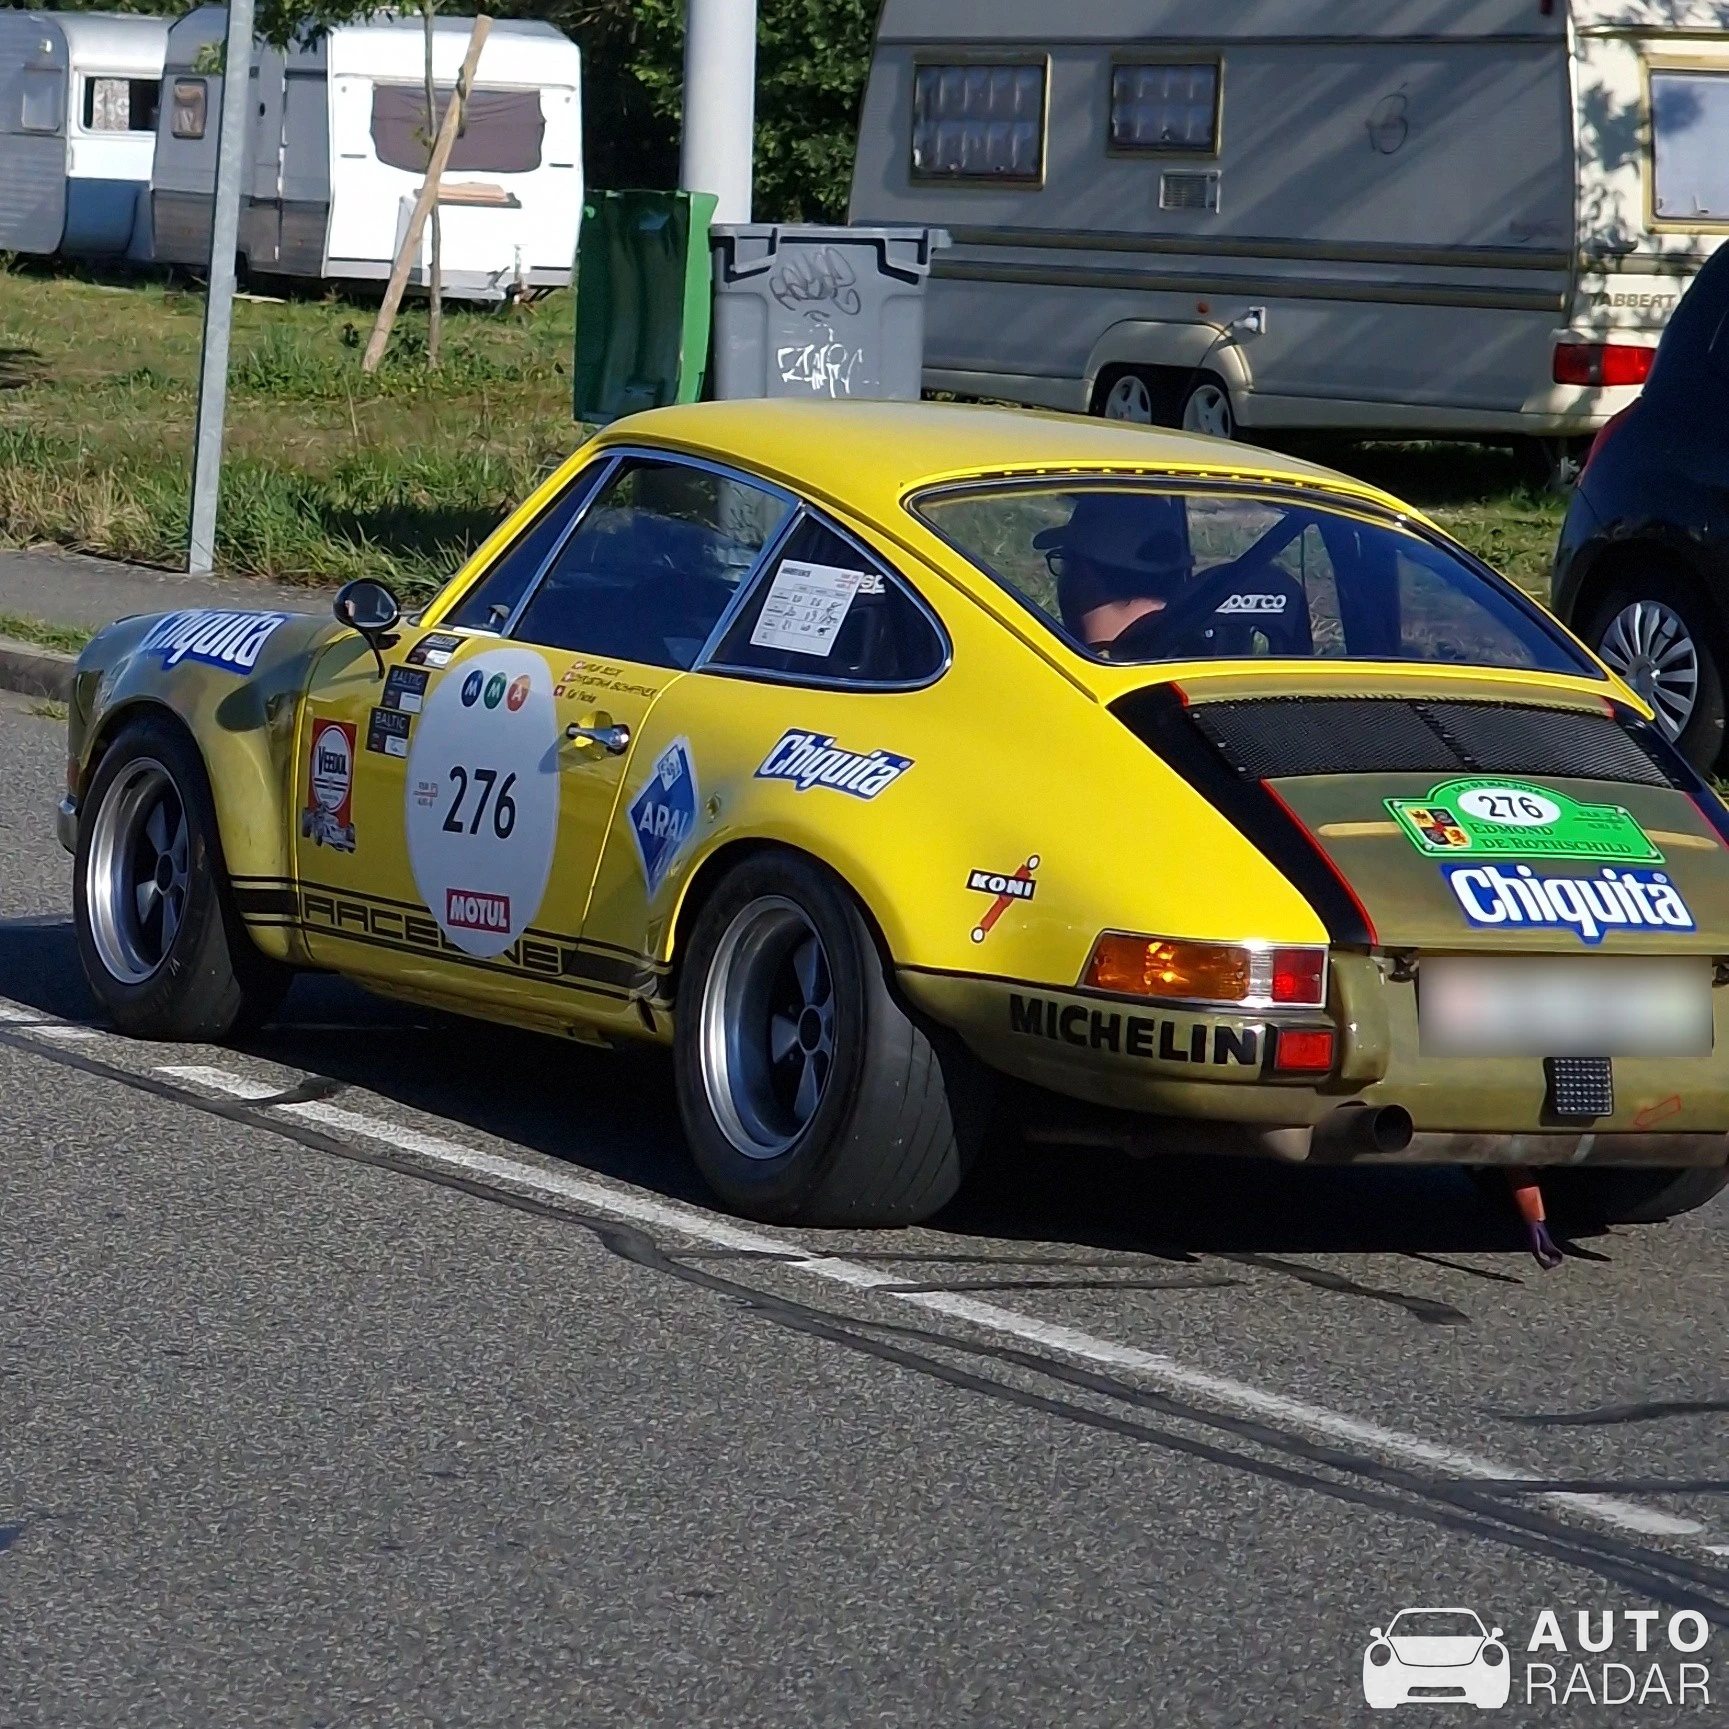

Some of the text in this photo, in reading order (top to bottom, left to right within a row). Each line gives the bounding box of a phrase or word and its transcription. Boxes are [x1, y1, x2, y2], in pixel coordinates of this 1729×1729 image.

[375, 711, 407, 729] BALTIC
[759, 734, 901, 797] Chiquita
[442, 765, 517, 840] 276
[1478, 795, 1544, 819] 276
[1469, 822, 1554, 836] EDMOND
[1510, 837, 1632, 854] ROTHSCHILD
[971, 873, 1033, 897] KONI
[450, 894, 508, 927] MOTUL
[1451, 865, 1693, 938] Chiquita
[1009, 993, 1257, 1066] MICHELIN
